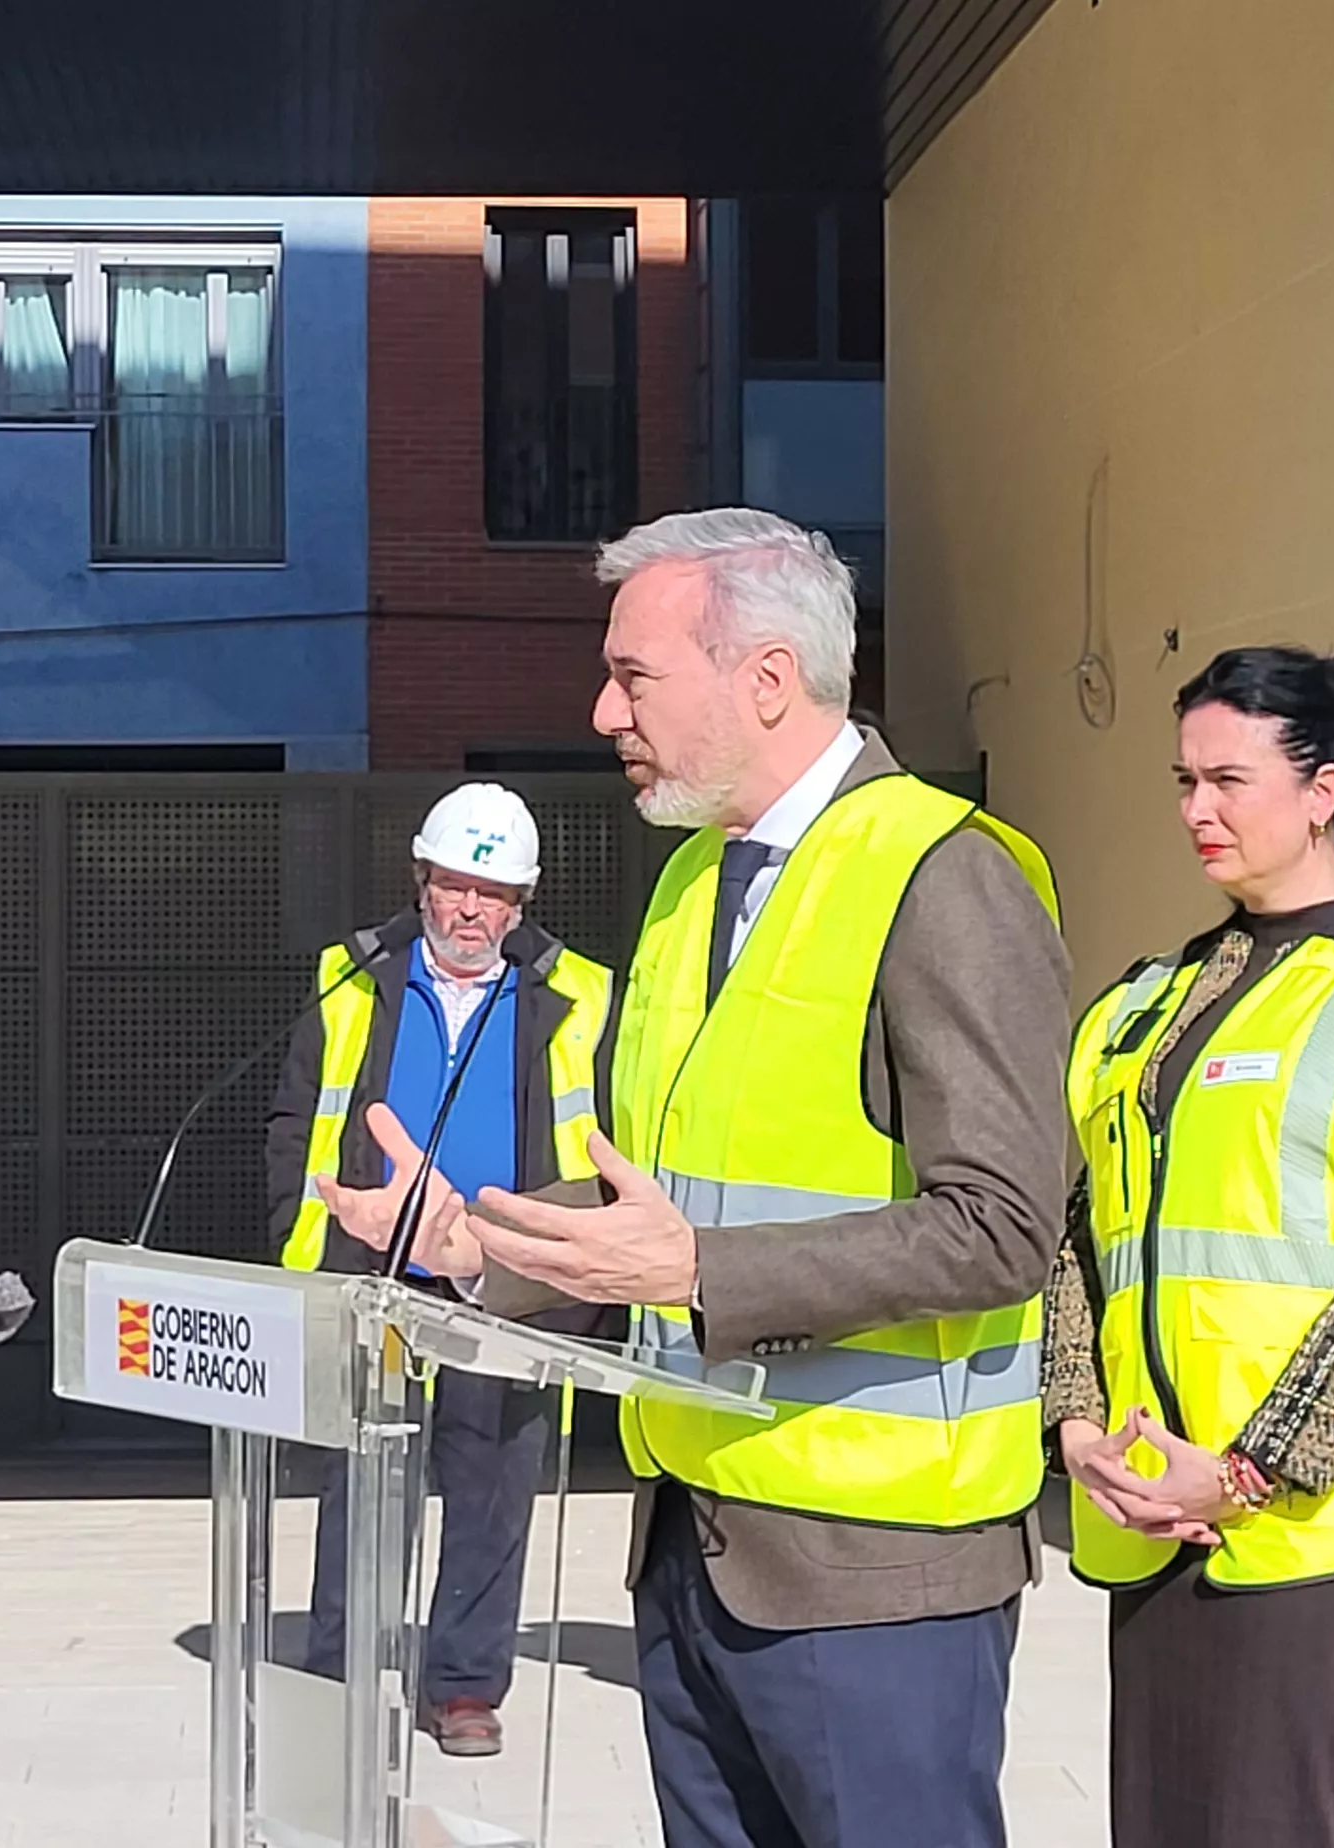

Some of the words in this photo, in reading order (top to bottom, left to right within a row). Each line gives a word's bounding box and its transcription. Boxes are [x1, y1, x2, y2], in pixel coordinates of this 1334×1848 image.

[152, 1303, 251, 1352] GOBIERNO
[153, 1344, 177, 1381] DE
[183, 1349, 266, 1398] ARAGON
